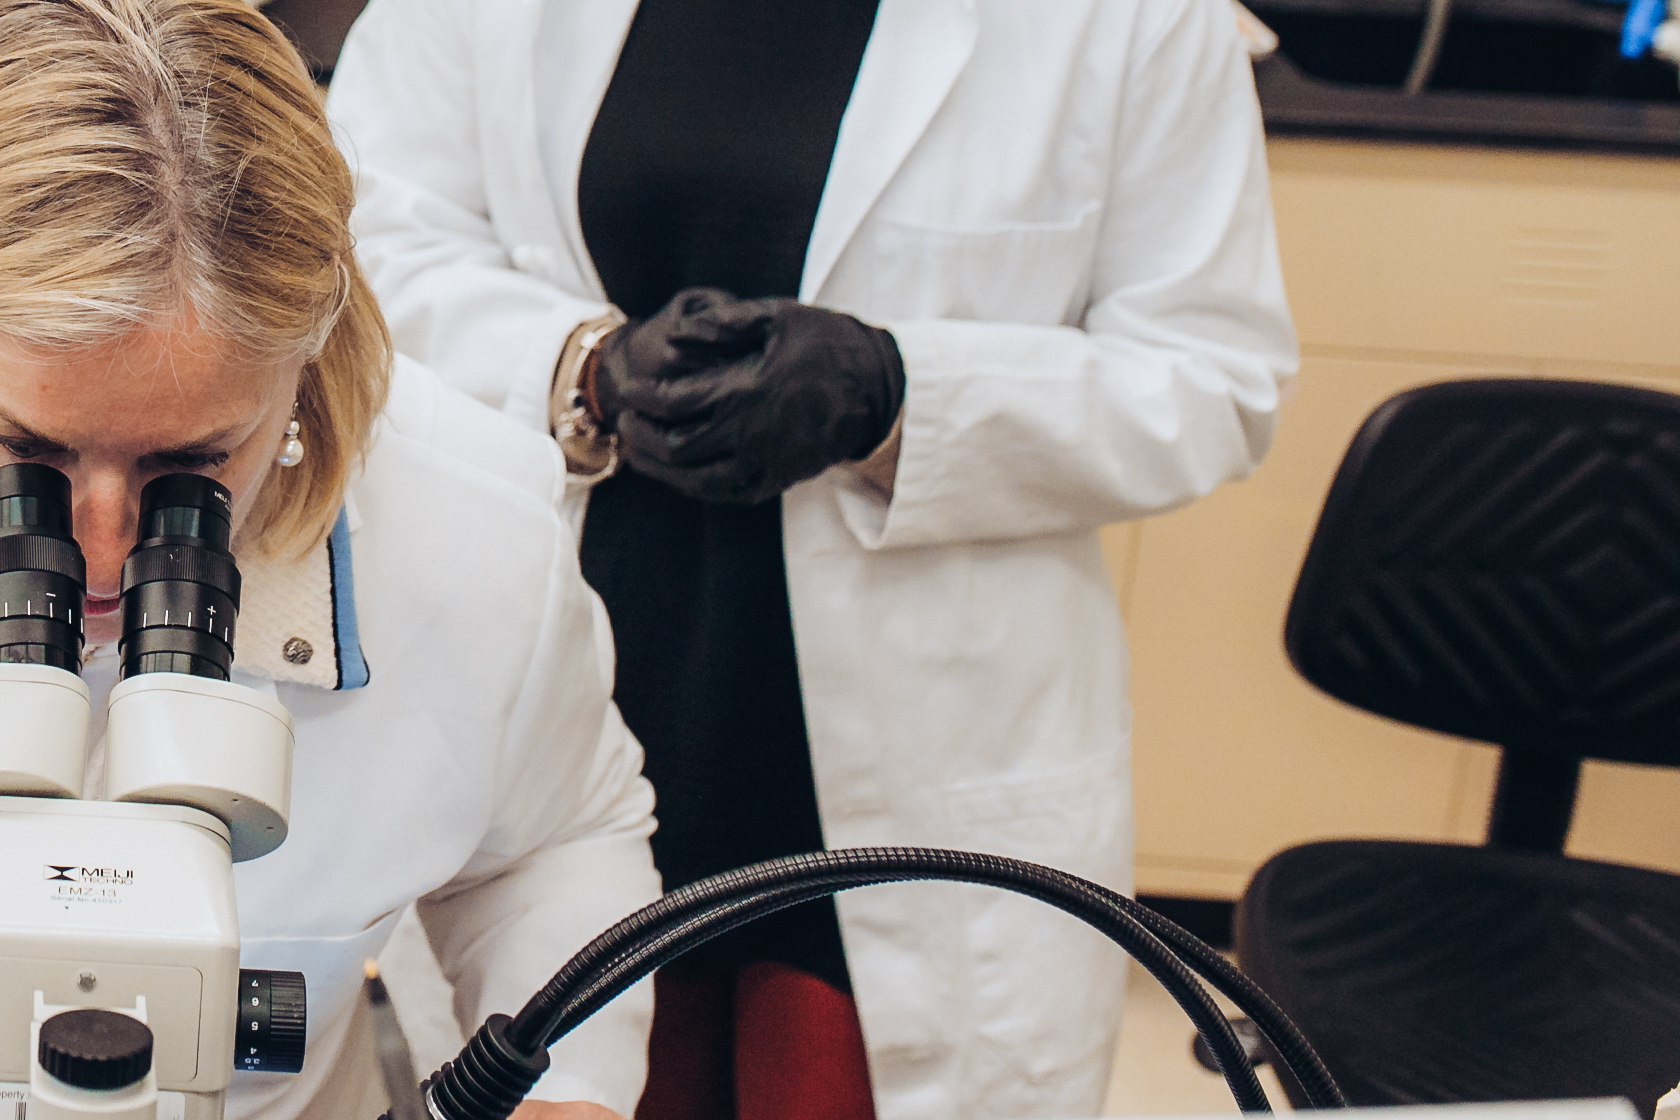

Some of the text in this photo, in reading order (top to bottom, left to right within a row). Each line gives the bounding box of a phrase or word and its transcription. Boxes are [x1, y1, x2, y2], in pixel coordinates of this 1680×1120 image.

[81, 867, 134, 878] MEIJI
[83, 876, 134, 885] TECHNO
[58, 886, 116, 896] EMZ-13
